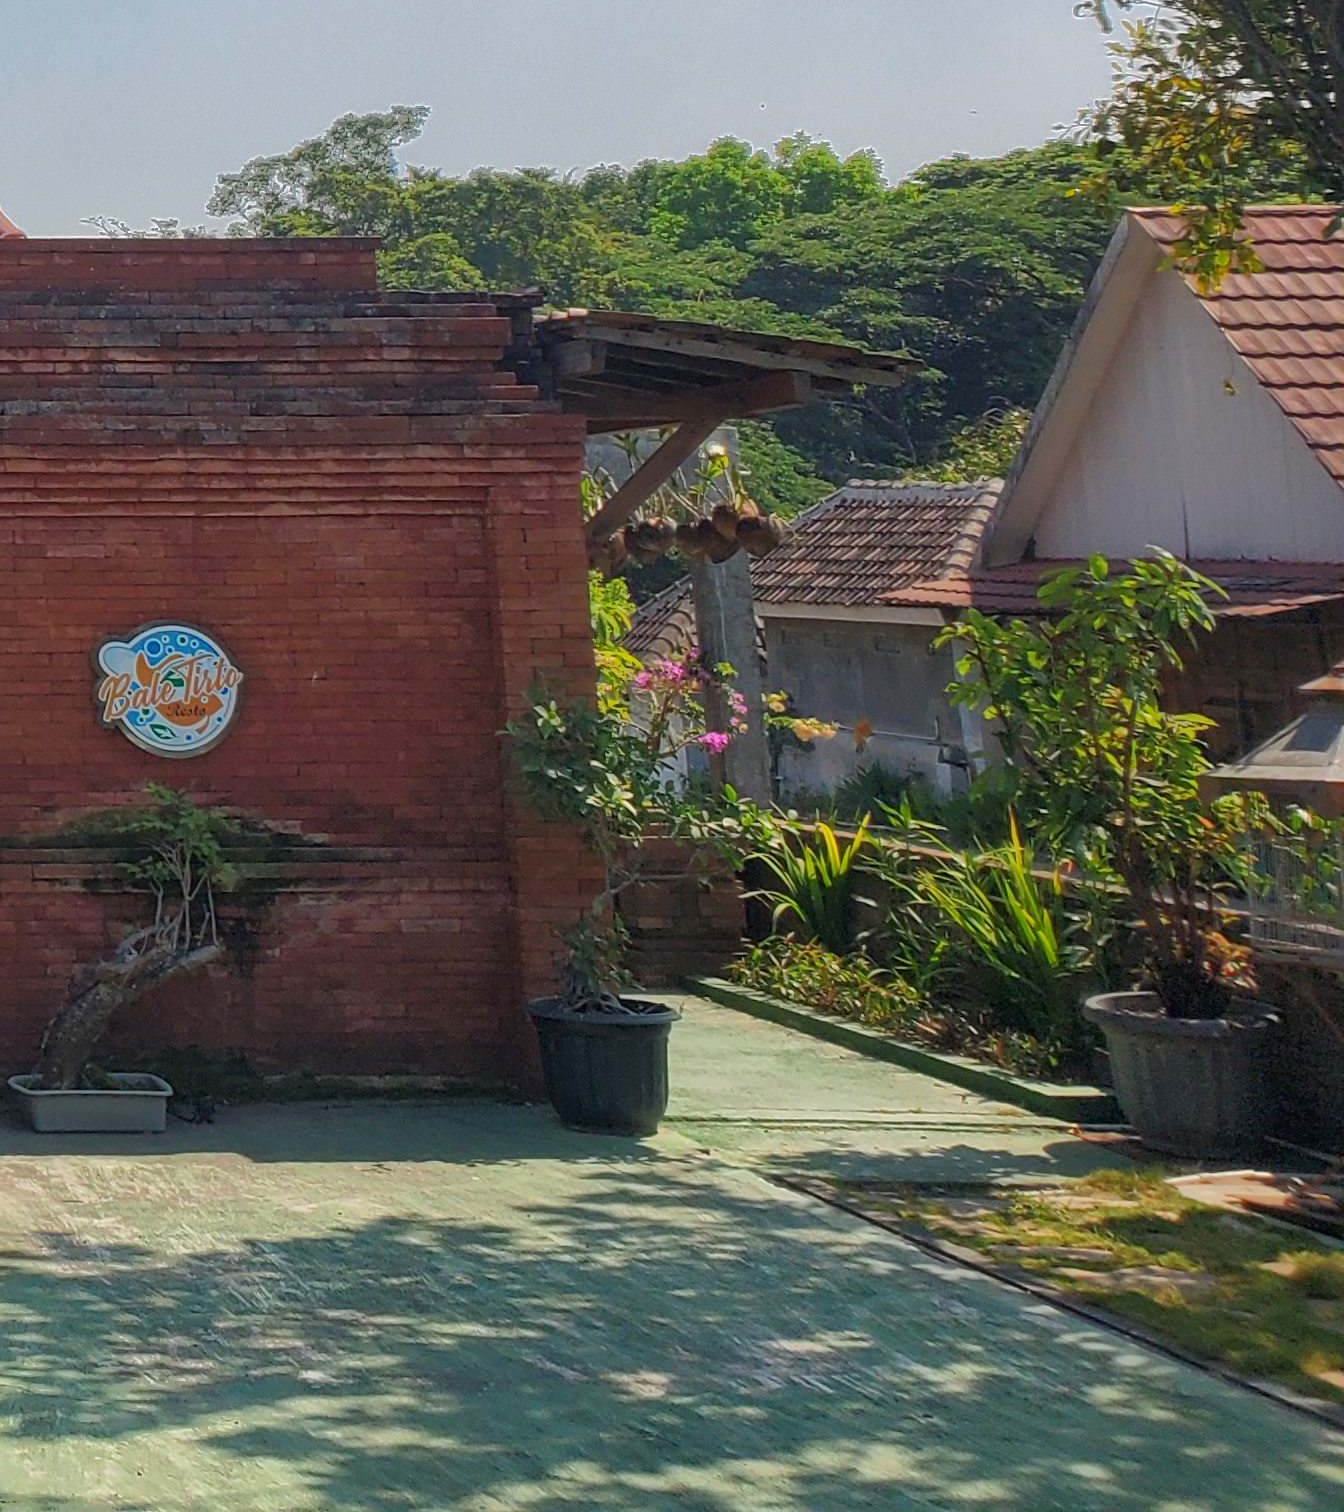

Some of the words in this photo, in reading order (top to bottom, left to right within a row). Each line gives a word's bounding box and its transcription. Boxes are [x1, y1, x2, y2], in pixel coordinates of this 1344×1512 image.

[99, 670, 176, 722] Bale
[171, 653, 243, 704] Tirto
[167, 703, 207, 717] Resto
